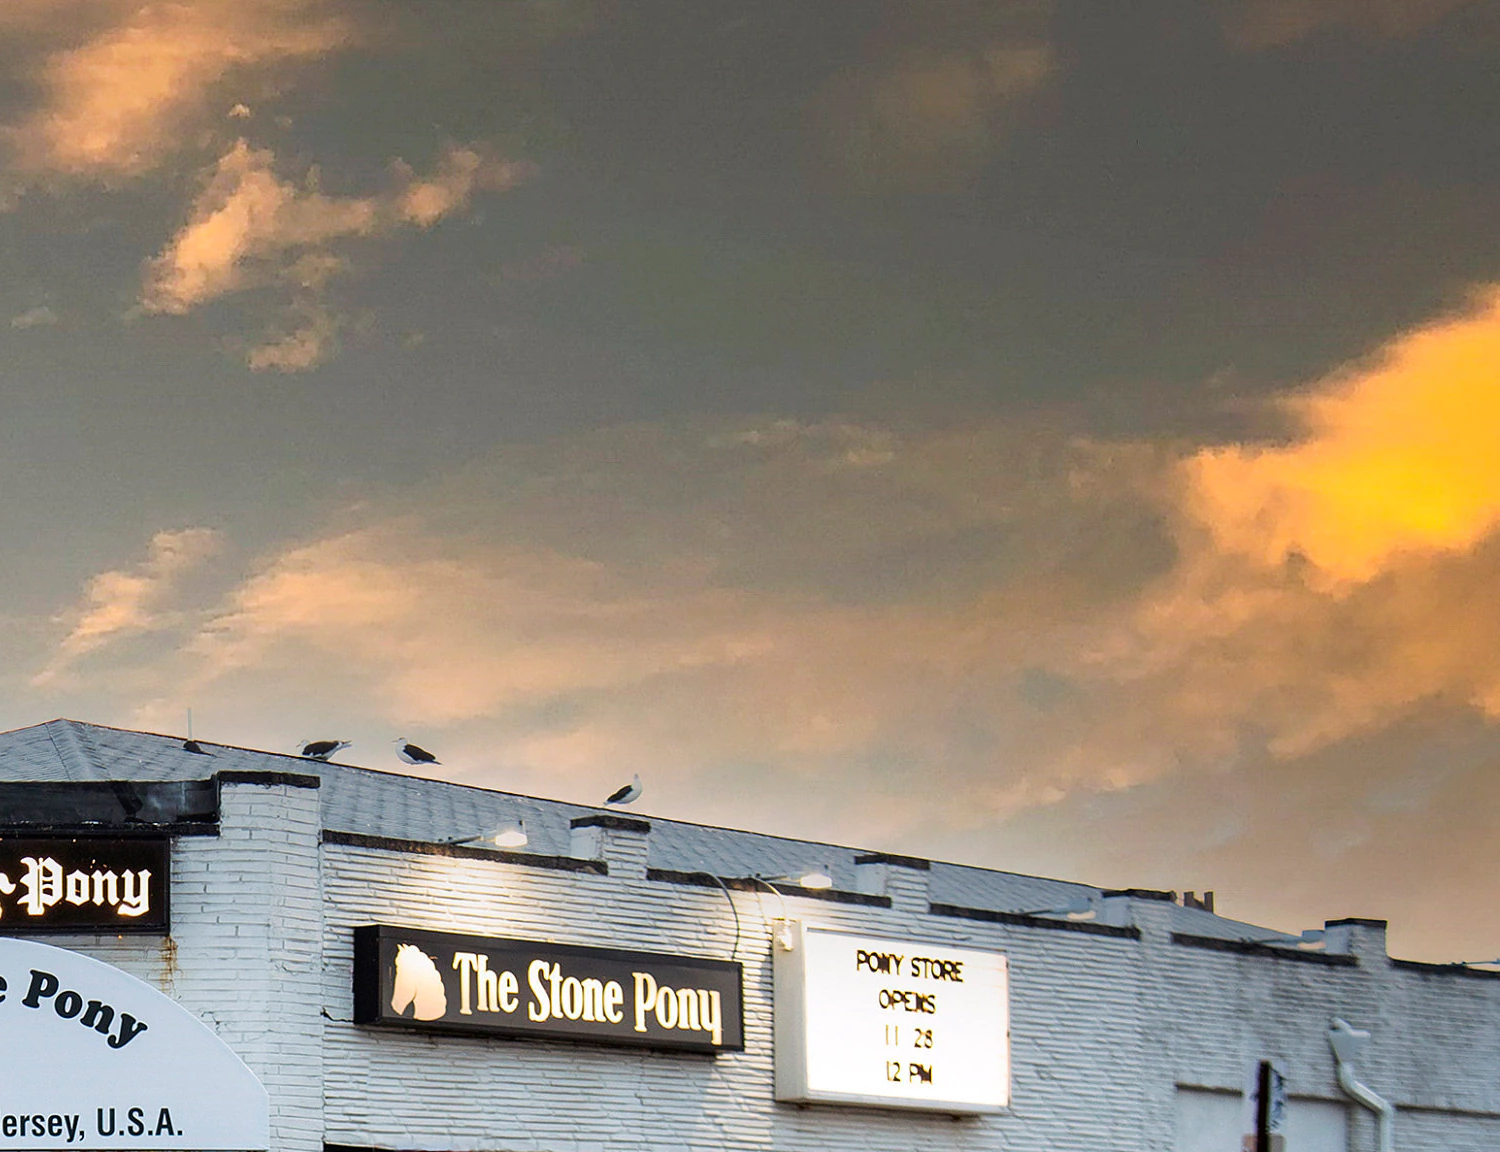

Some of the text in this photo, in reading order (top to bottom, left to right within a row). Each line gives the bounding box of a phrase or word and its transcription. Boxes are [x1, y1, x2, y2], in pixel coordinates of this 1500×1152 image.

[17, 855, 152, 917] Pony
[856, 949, 964, 982] PONY STORE
[21, 968, 148, 1049] Pony
[452, 952, 723, 1045] The Stone Pony
[878, 989, 936, 1014] OPENS
[914, 1028, 933, 1049] 28
[886, 1060, 933, 1085] 12 PM
[96, 1106, 184, 1138] U.S.A.
